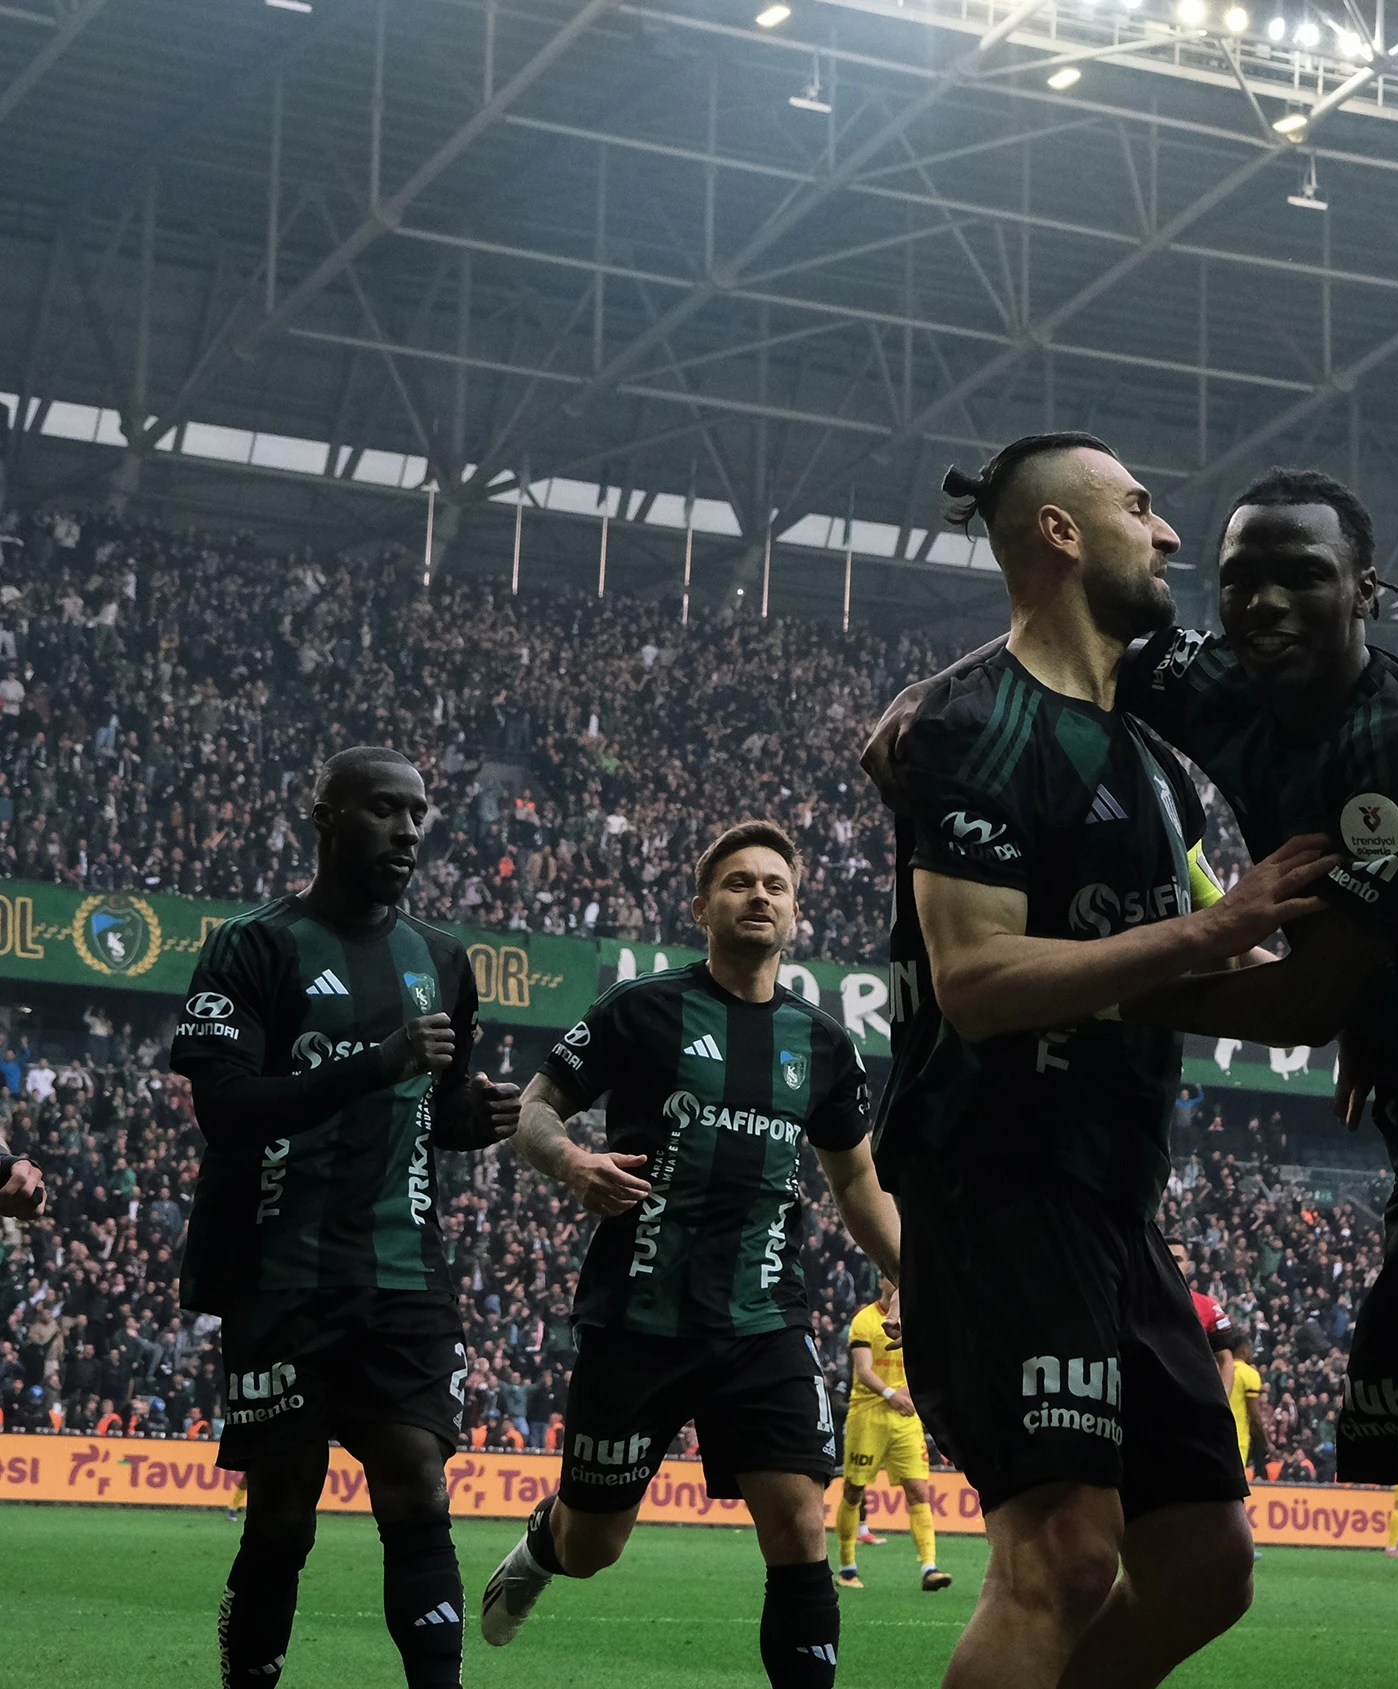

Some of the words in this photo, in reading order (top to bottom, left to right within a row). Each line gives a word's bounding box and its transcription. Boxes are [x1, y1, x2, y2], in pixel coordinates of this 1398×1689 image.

[1351, 836, 1395, 847] trendyol
[176, 1021, 240, 1041] HYUNDAI
[1022, 1355, 1122, 1414] nuh
[1023, 1401, 1123, 1446] çimento
[573, 1432, 652, 1465] nuh
[571, 1463, 651, 1487] çimento
